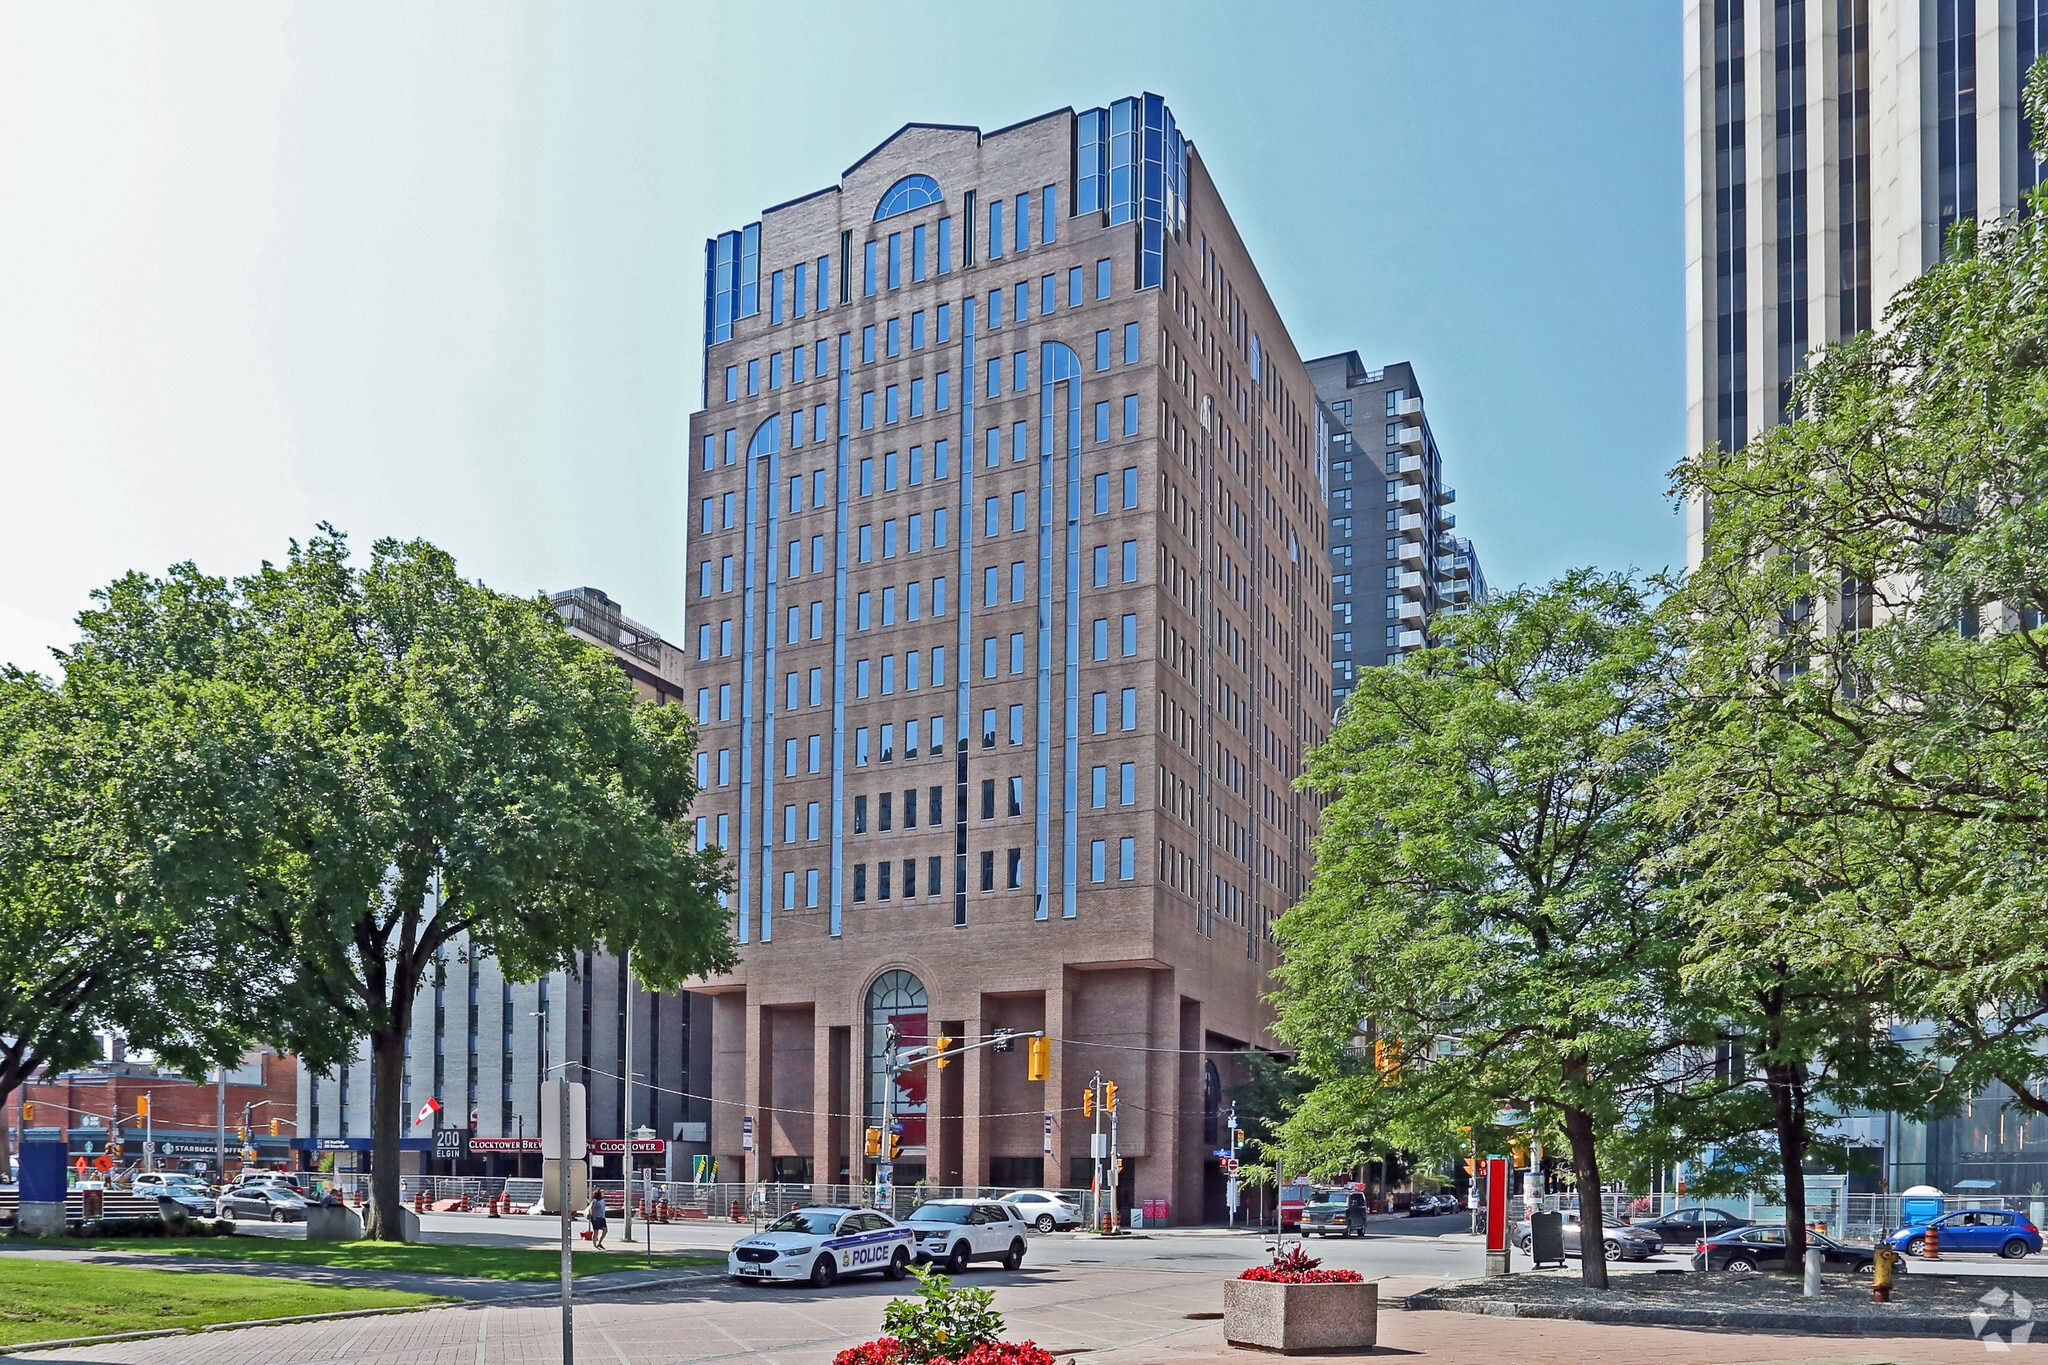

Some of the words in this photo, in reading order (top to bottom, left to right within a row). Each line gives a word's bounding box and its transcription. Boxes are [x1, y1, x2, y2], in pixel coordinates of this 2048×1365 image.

[436, 1131, 460, 1147] 200
[175, 1145, 218, 1153] STARBUCKS
[468, 1140, 520, 1149] CLOCKTOWER
[436, 1149, 460, 1158] ELGIN
[852, 1245, 889, 1266] POLICE
